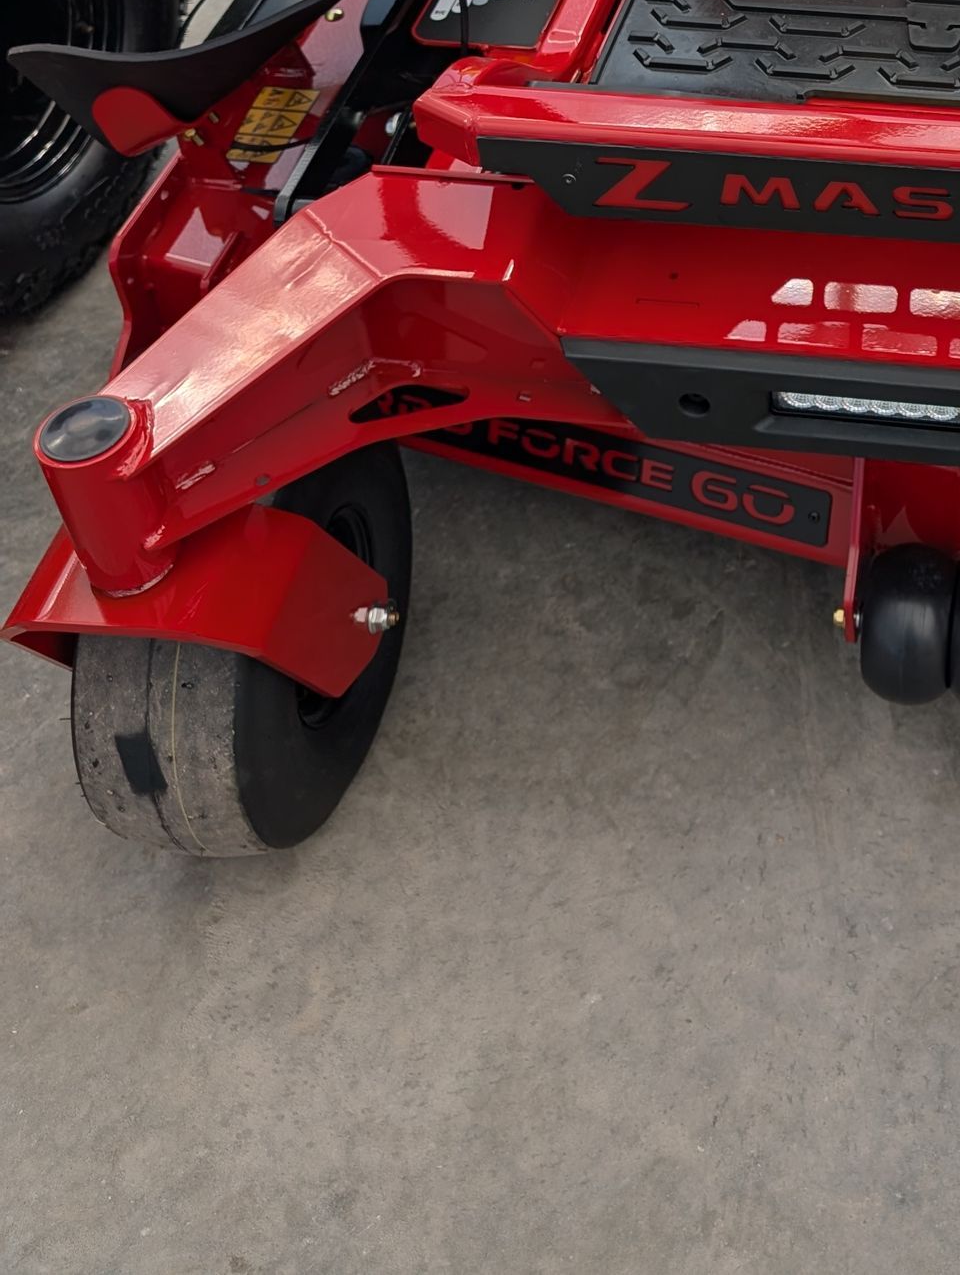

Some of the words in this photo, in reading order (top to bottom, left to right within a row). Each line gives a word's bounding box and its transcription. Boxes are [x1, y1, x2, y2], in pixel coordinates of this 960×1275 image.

[594, 157, 692, 212] Z
[487, 418, 676, 493] FORCE
[690, 470, 795, 526] 60
